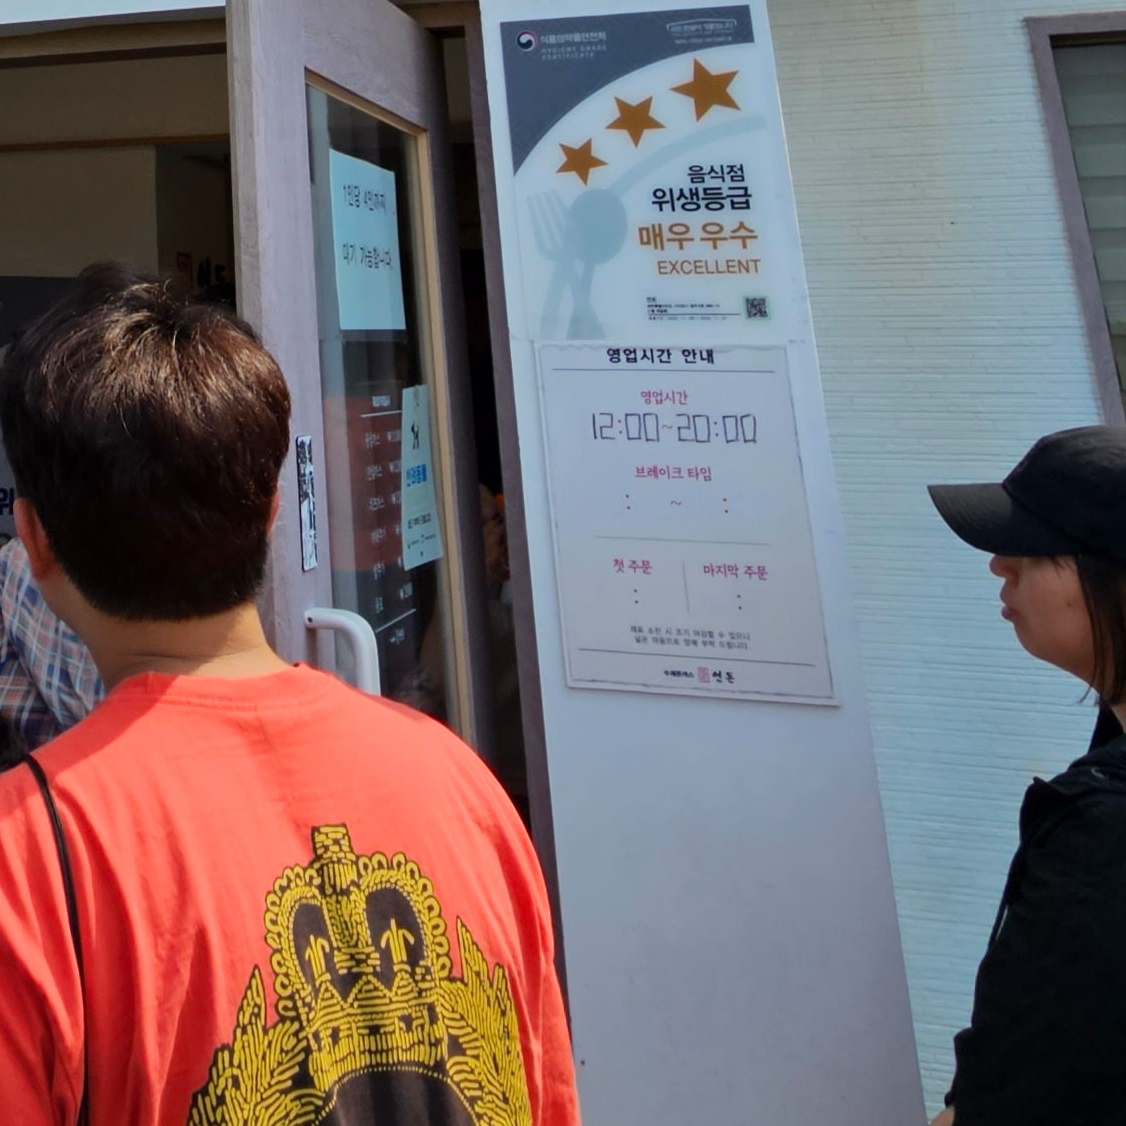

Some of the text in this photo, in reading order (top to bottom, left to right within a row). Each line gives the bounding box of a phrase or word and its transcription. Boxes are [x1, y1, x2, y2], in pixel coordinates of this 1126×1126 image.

[687, 164, 745, 184] 음식점
[652, 186, 752, 212] 위생등급
[638, 221, 758, 251] 매우 우수
[657, 259, 761, 275] EXCELLENT
[606, 348, 715, 365] 영업시간 안내
[640, 390, 689, 405] 영업시간
[634, 465, 712, 481] 브레이크 타임
[613, 558, 653, 575] 첫 주문
[703, 563, 768, 580] 마지막 주문
